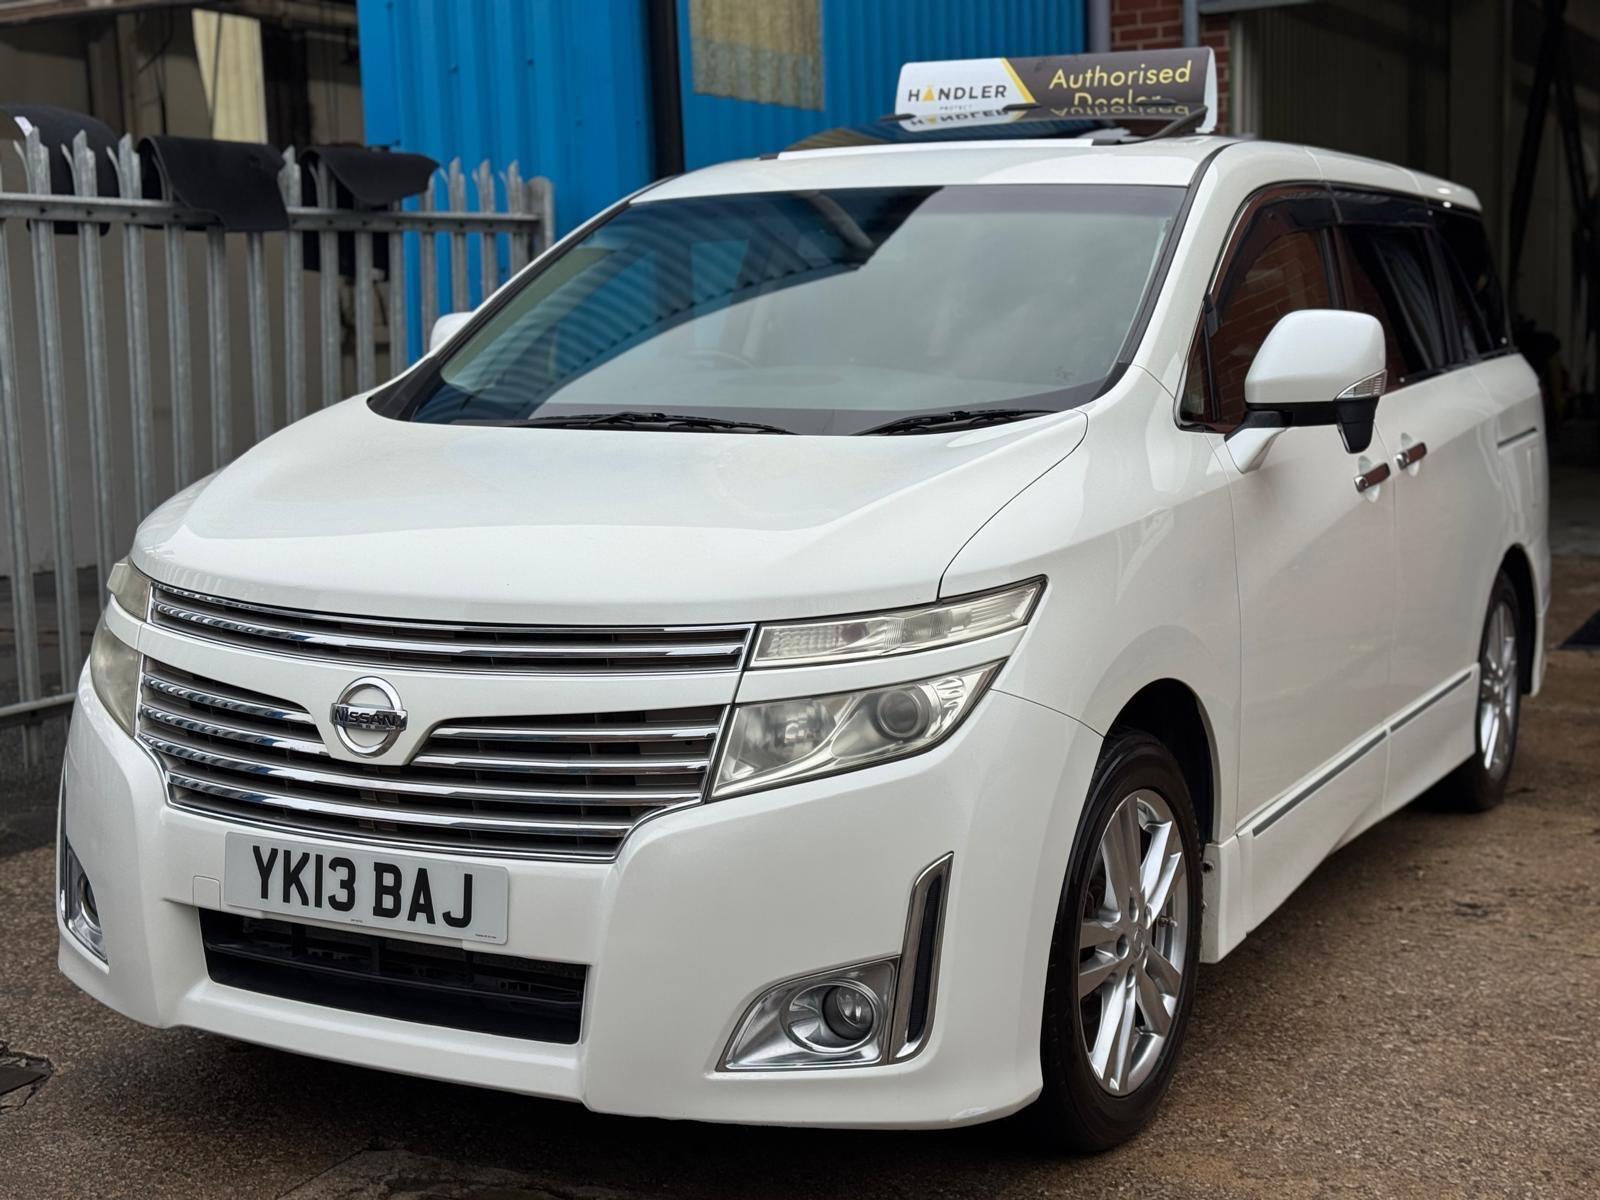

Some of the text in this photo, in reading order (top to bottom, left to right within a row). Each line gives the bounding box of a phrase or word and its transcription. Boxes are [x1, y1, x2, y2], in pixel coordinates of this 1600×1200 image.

[1048, 59, 1193, 90] Authorised
[907, 84, 1008, 103] HANDLER
[334, 706, 396, 727] NISSAN
[252, 845, 473, 929] YK13 BAJ
